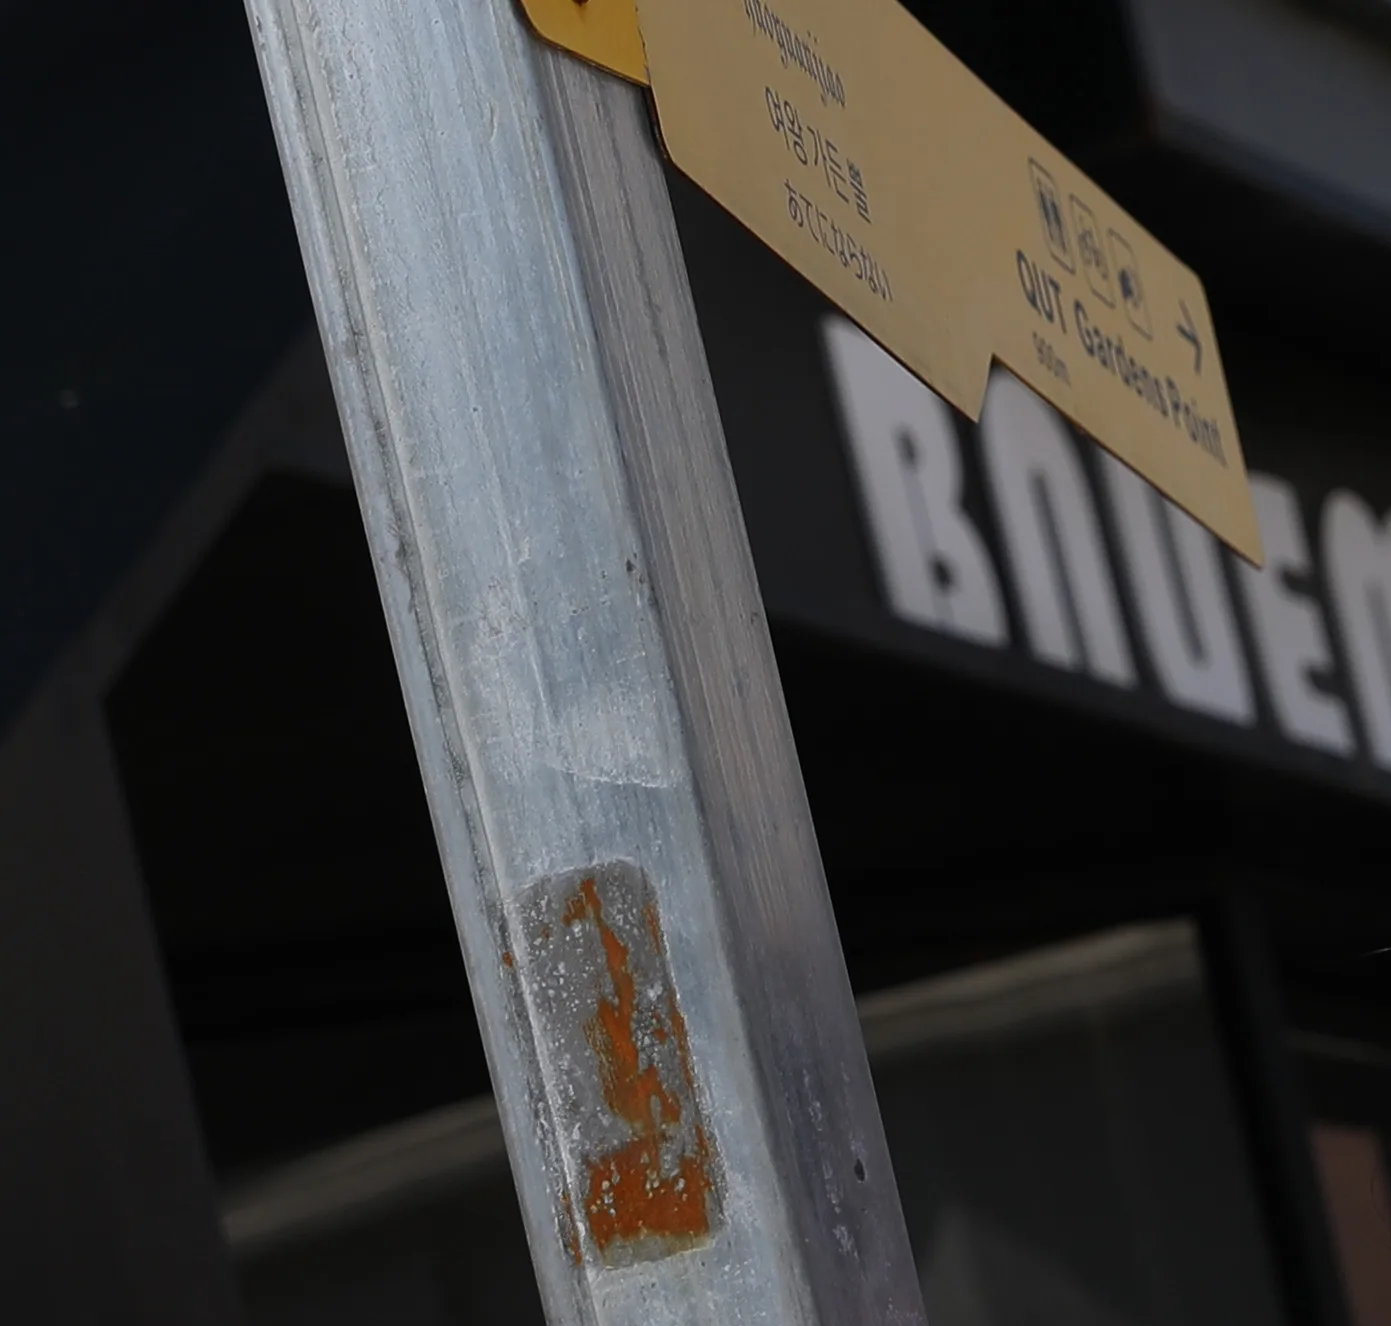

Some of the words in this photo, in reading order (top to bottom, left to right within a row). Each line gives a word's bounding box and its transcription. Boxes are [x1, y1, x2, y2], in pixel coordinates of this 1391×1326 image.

[764, 85, 808, 166] 여왕
[784, 178, 893, 302] あてにならない
[1015, 249, 1068, 335] QUT
[1073, 298, 1170, 420] Gardens
[1164, 375, 1229, 468] Point
